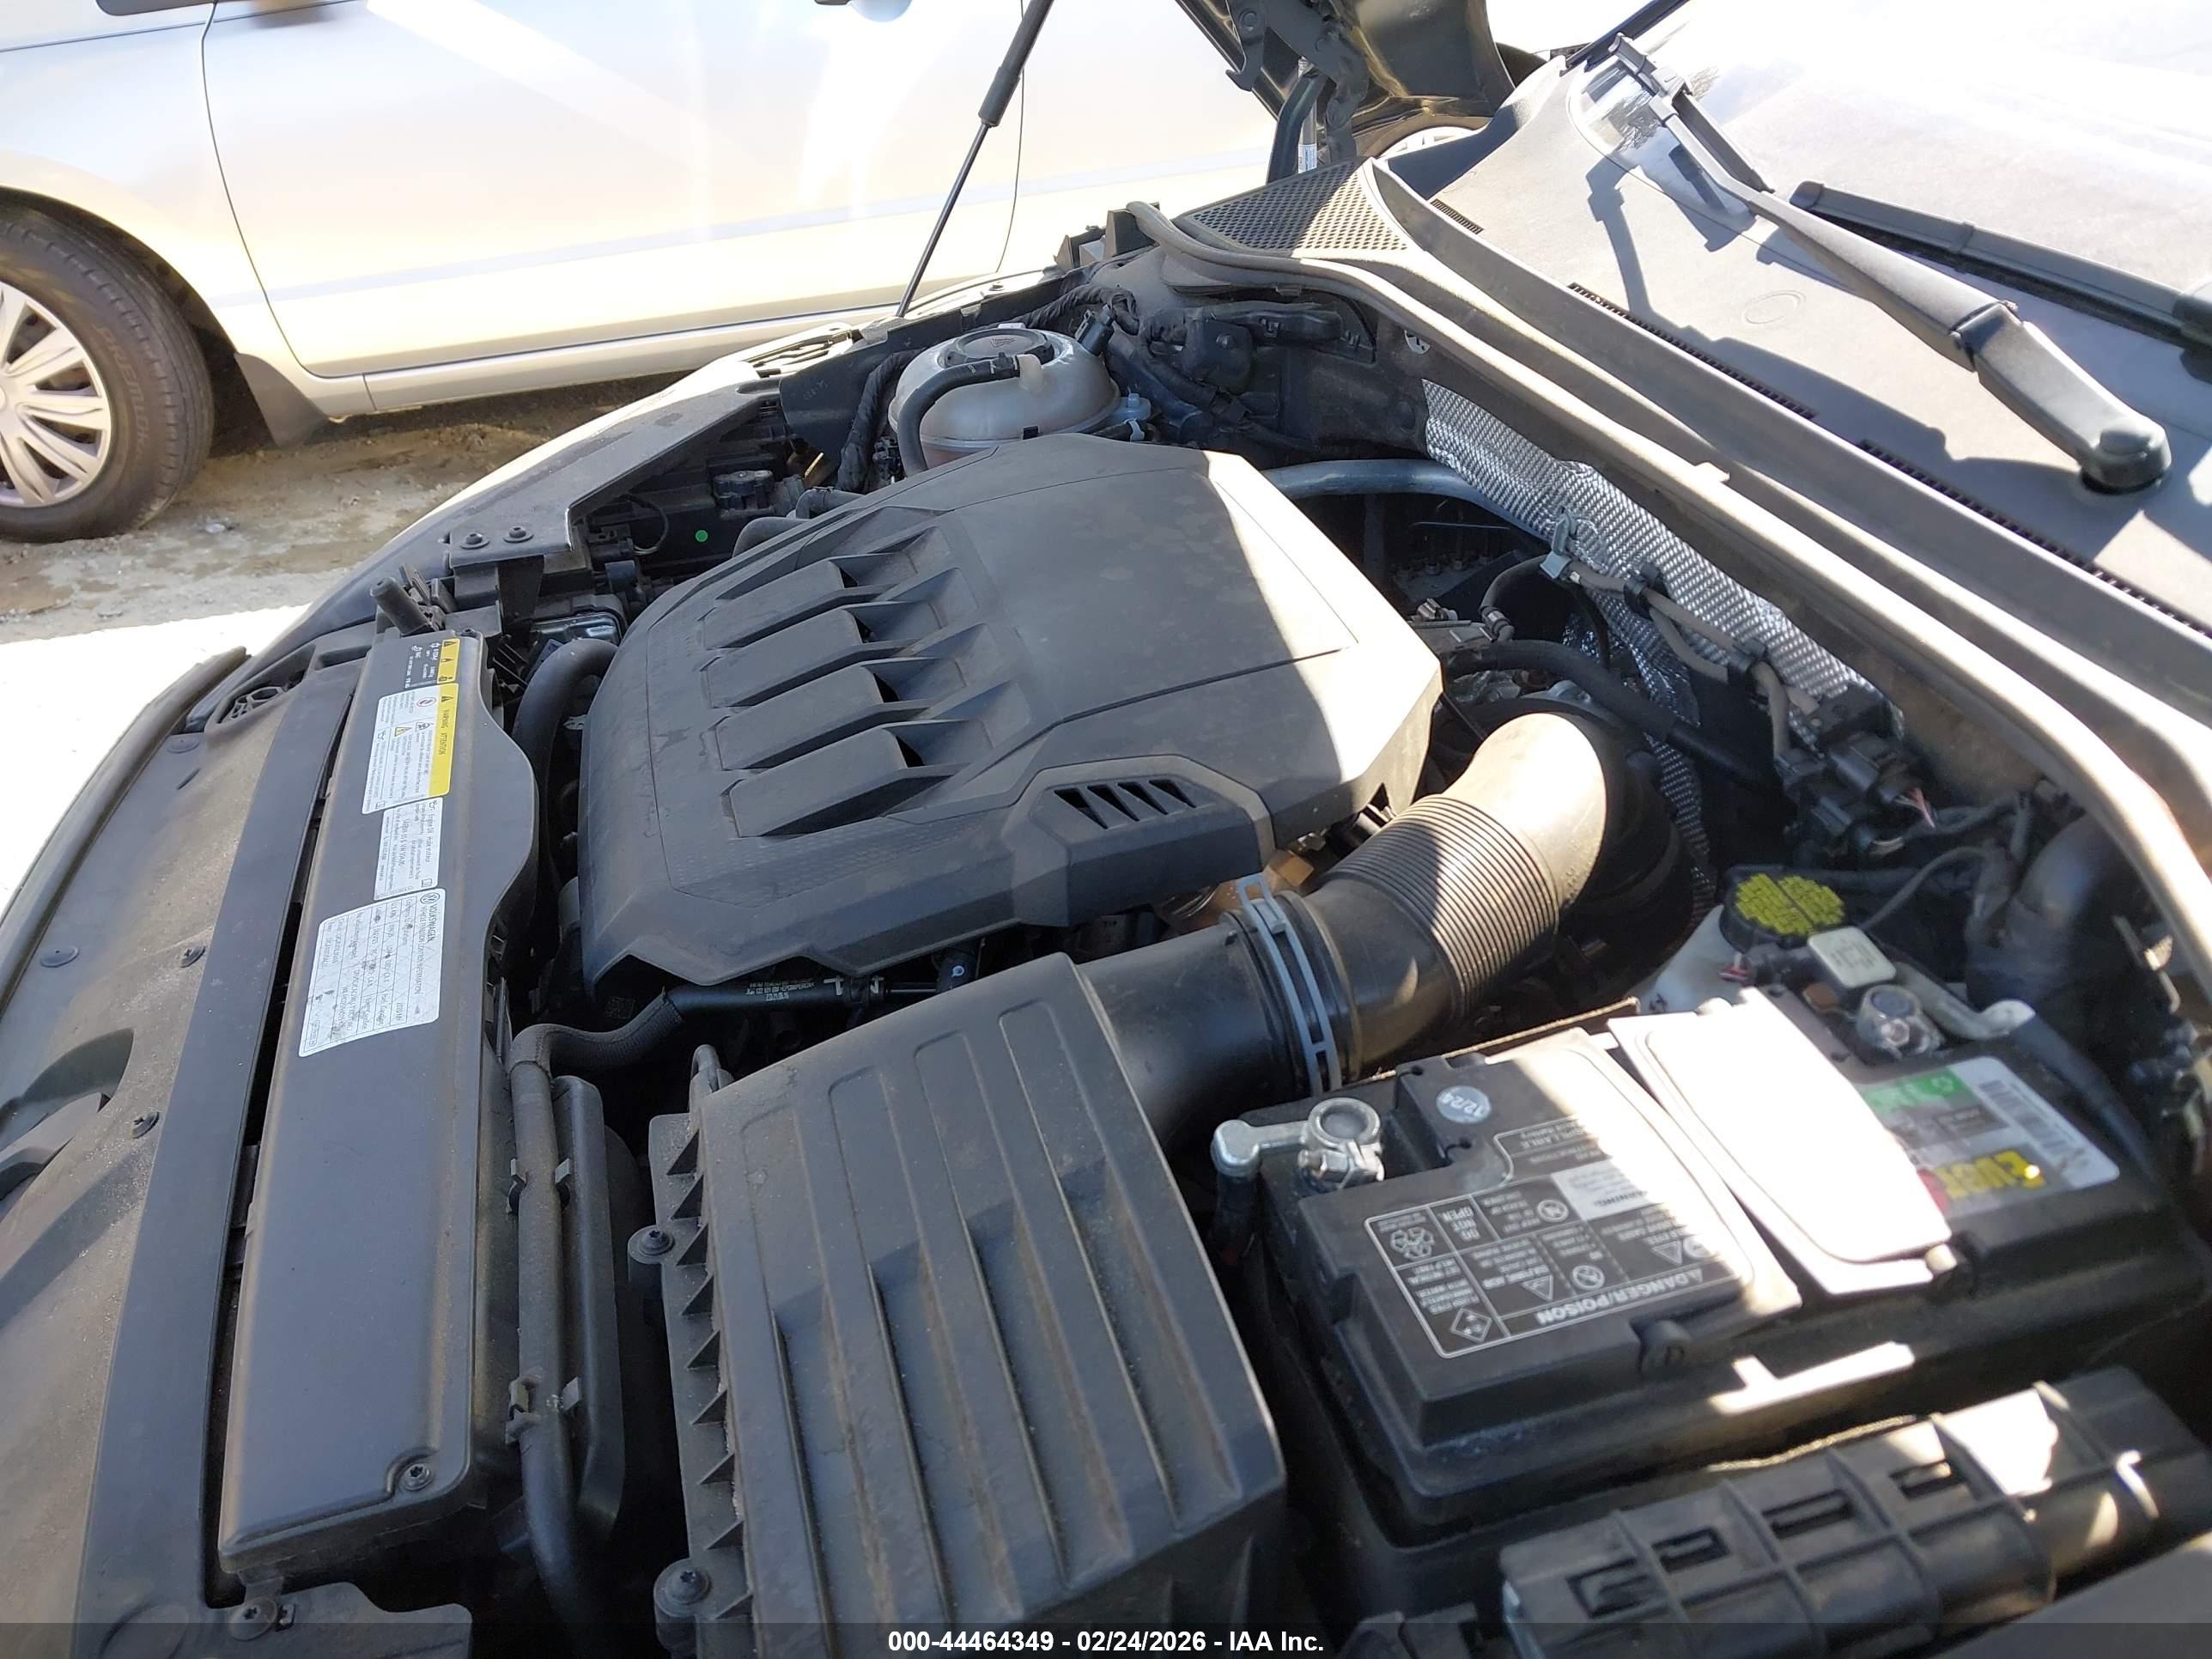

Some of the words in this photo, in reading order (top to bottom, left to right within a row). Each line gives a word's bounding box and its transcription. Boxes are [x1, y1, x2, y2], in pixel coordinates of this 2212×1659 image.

[441, 708, 450, 729] WARNING
[438, 731, 447, 756] ATTENTION
[414, 963, 422, 994] INFORMATION
[1450, 1218, 1476, 1233] NOT
[1461, 1228, 1480, 1242] DO
[1535, 1273, 1689, 1325] DANGER/POISON
